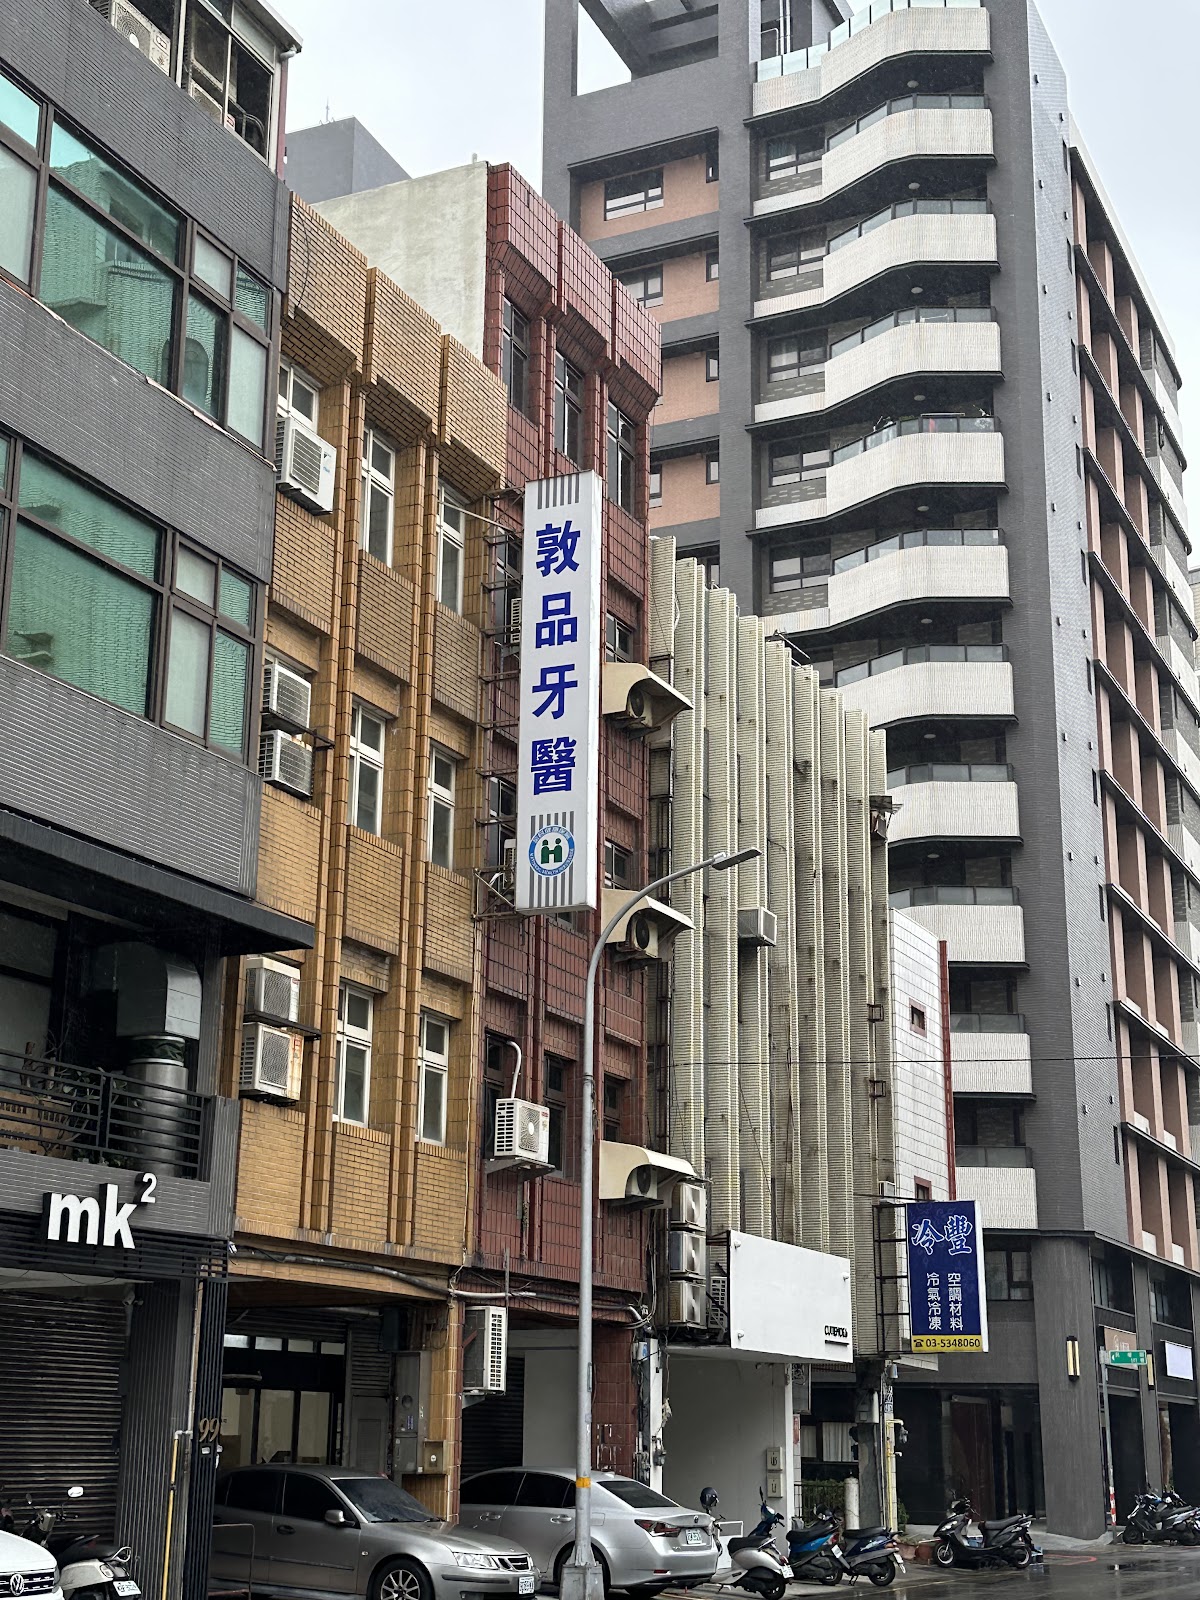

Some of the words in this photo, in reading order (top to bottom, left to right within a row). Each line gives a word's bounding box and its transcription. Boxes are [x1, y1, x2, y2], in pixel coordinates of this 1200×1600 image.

[531, 520, 581, 795] 敦品牙醫
[926, 1271, 942, 1331] 冷氣冷凍
[947, 1272, 964, 1332] 空調材料
[925, 1338, 981, 1348] 03-5348060
[199, 1417, 220, 1442] 99
